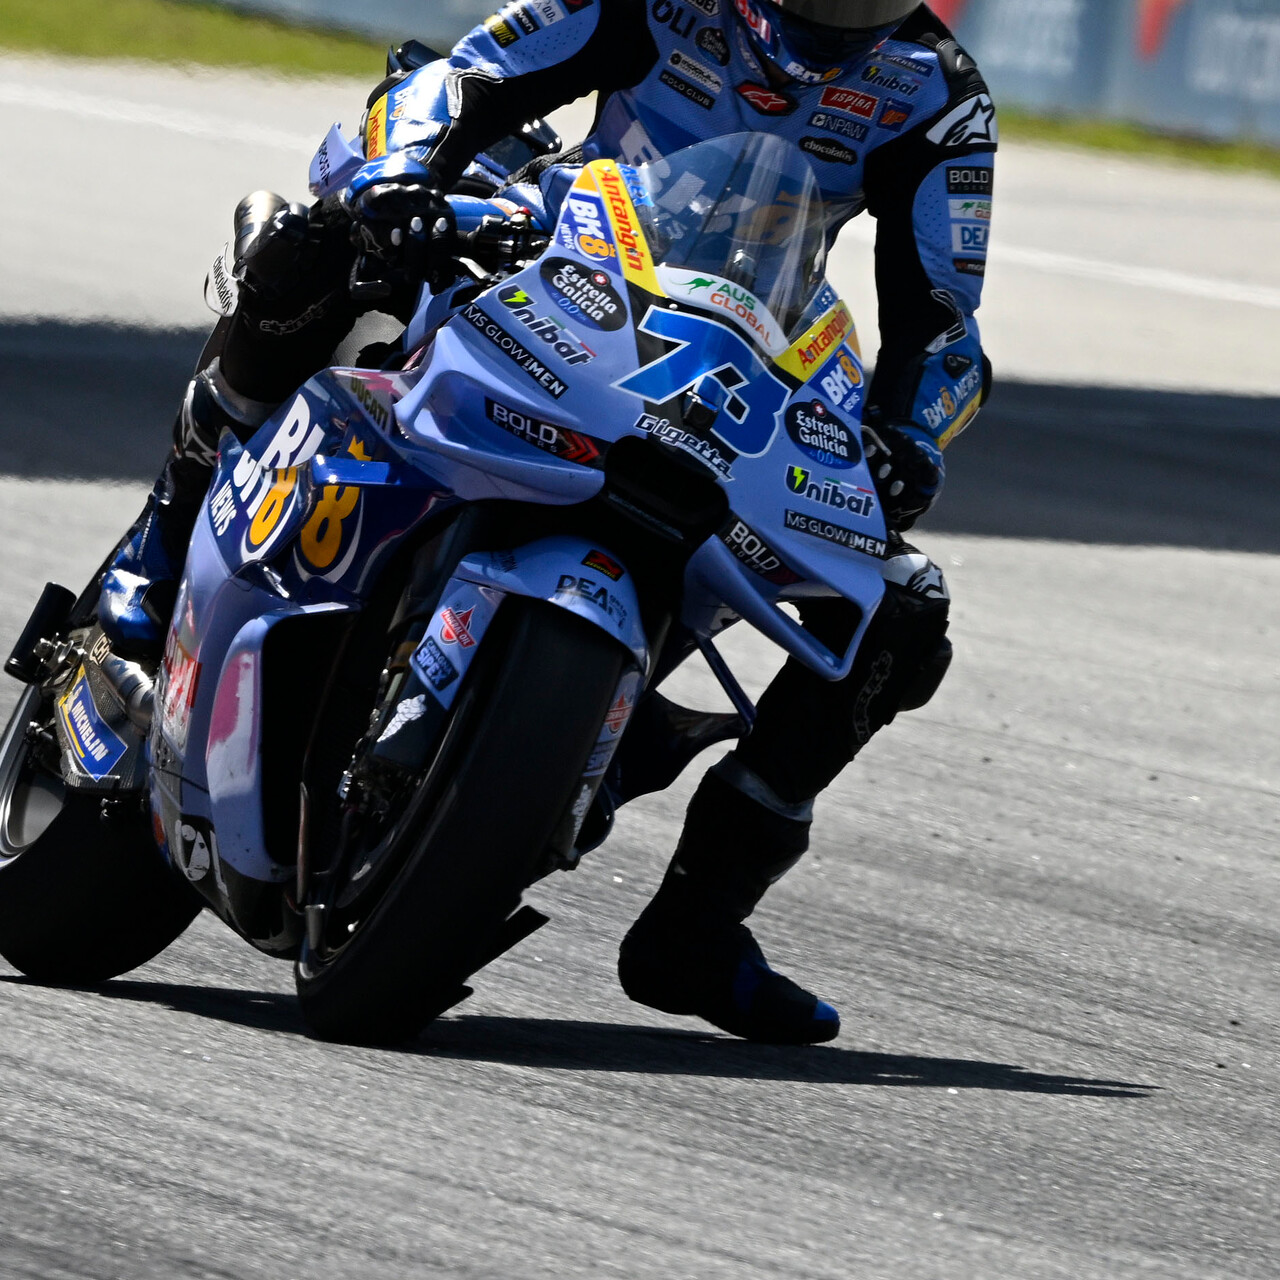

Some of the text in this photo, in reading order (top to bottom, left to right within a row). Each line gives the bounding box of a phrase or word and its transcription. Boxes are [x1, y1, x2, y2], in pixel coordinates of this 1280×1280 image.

[661, 72, 686, 91] POLO
[686, 87, 712, 106] CLUB
[830, 92, 873, 110] ASPIRA
[861, 65, 920, 97] Unibat
[949, 169, 990, 184] BOLD
[558, 222, 576, 251] NEWS
[567, 199, 616, 258] BK8
[596, 167, 645, 272] Antangin
[550, 264, 618, 315] Estrella
[552, 274, 606, 321] Galicia
[717, 283, 757, 310] AUS
[497, 283, 596, 367] Unibat
[710, 292, 773, 348] GLOBAL
[795, 307, 851, 372] Antangin
[463, 303, 566, 396] MS GLOW MEN
[608, 303, 794, 459] 73
[820, 349, 862, 406] BK8
[842, 391, 861, 414] NEWS
[491, 402, 559, 446] BOLD
[634, 411, 733, 473] Gigetta
[796, 409, 849, 444] Estrella
[798, 426, 849, 458] Galicia
[209, 479, 238, 538] NEWS
[784, 464, 876, 518] Unibat
[729, 521, 781, 572] BOLD
[785, 512, 887, 556] MS GLOW MEN
[416, 647, 448, 686] SIPEX
[70, 699, 108, 764] MICHELIN
